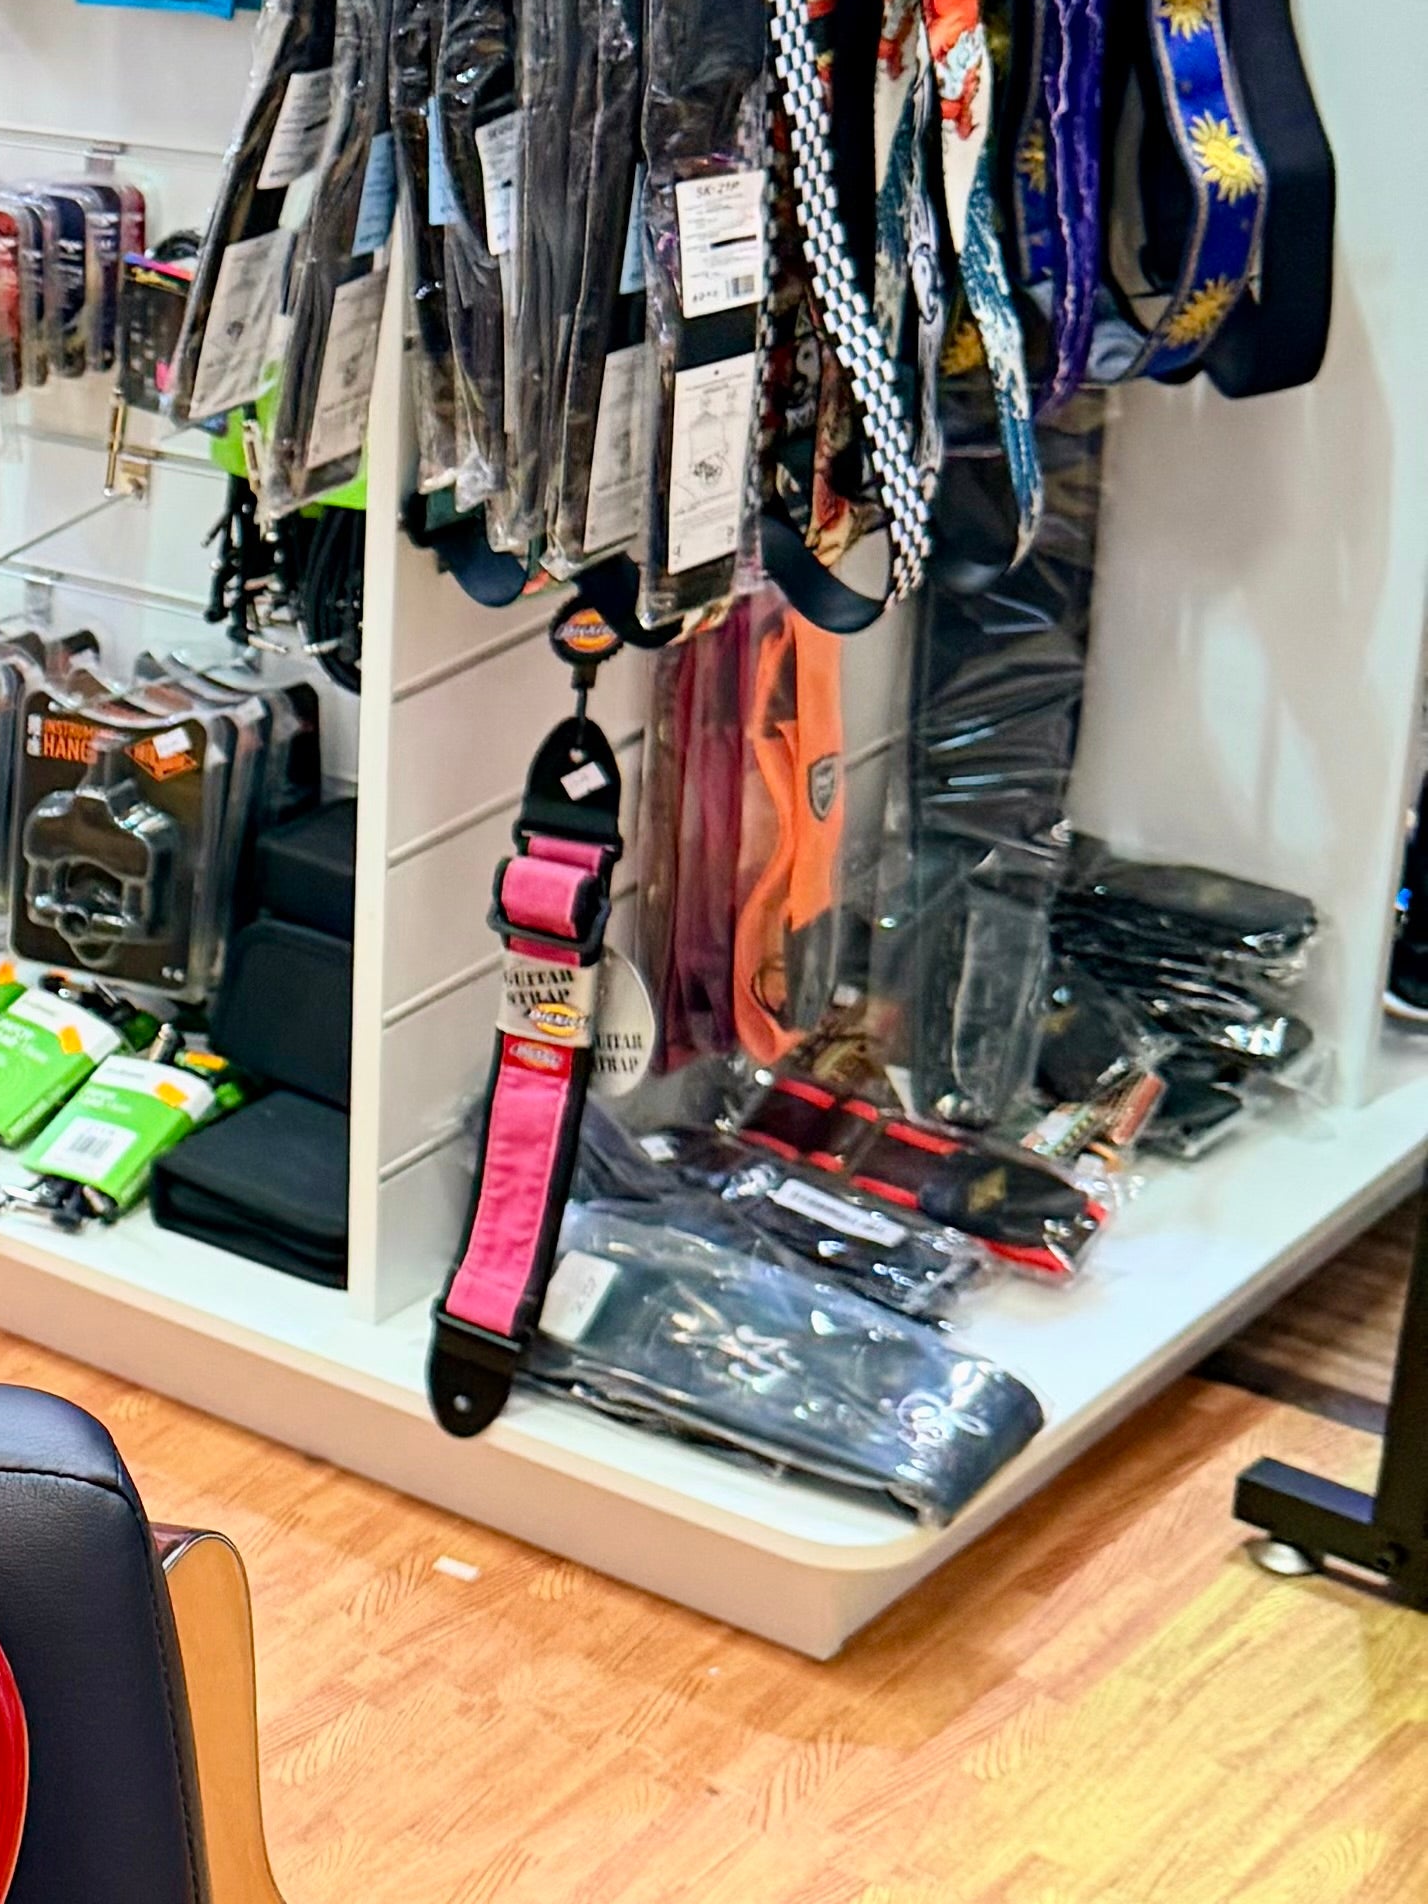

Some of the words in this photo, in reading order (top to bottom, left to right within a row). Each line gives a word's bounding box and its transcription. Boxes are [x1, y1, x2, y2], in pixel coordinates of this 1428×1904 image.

[43, 737, 98, 765] HANG
[503, 969, 574, 988] GUITAR
[506, 989, 570, 1005] STRAP
[596, 1033, 643, 1051] UITAR
[596, 1055, 639, 1074] TRAP
